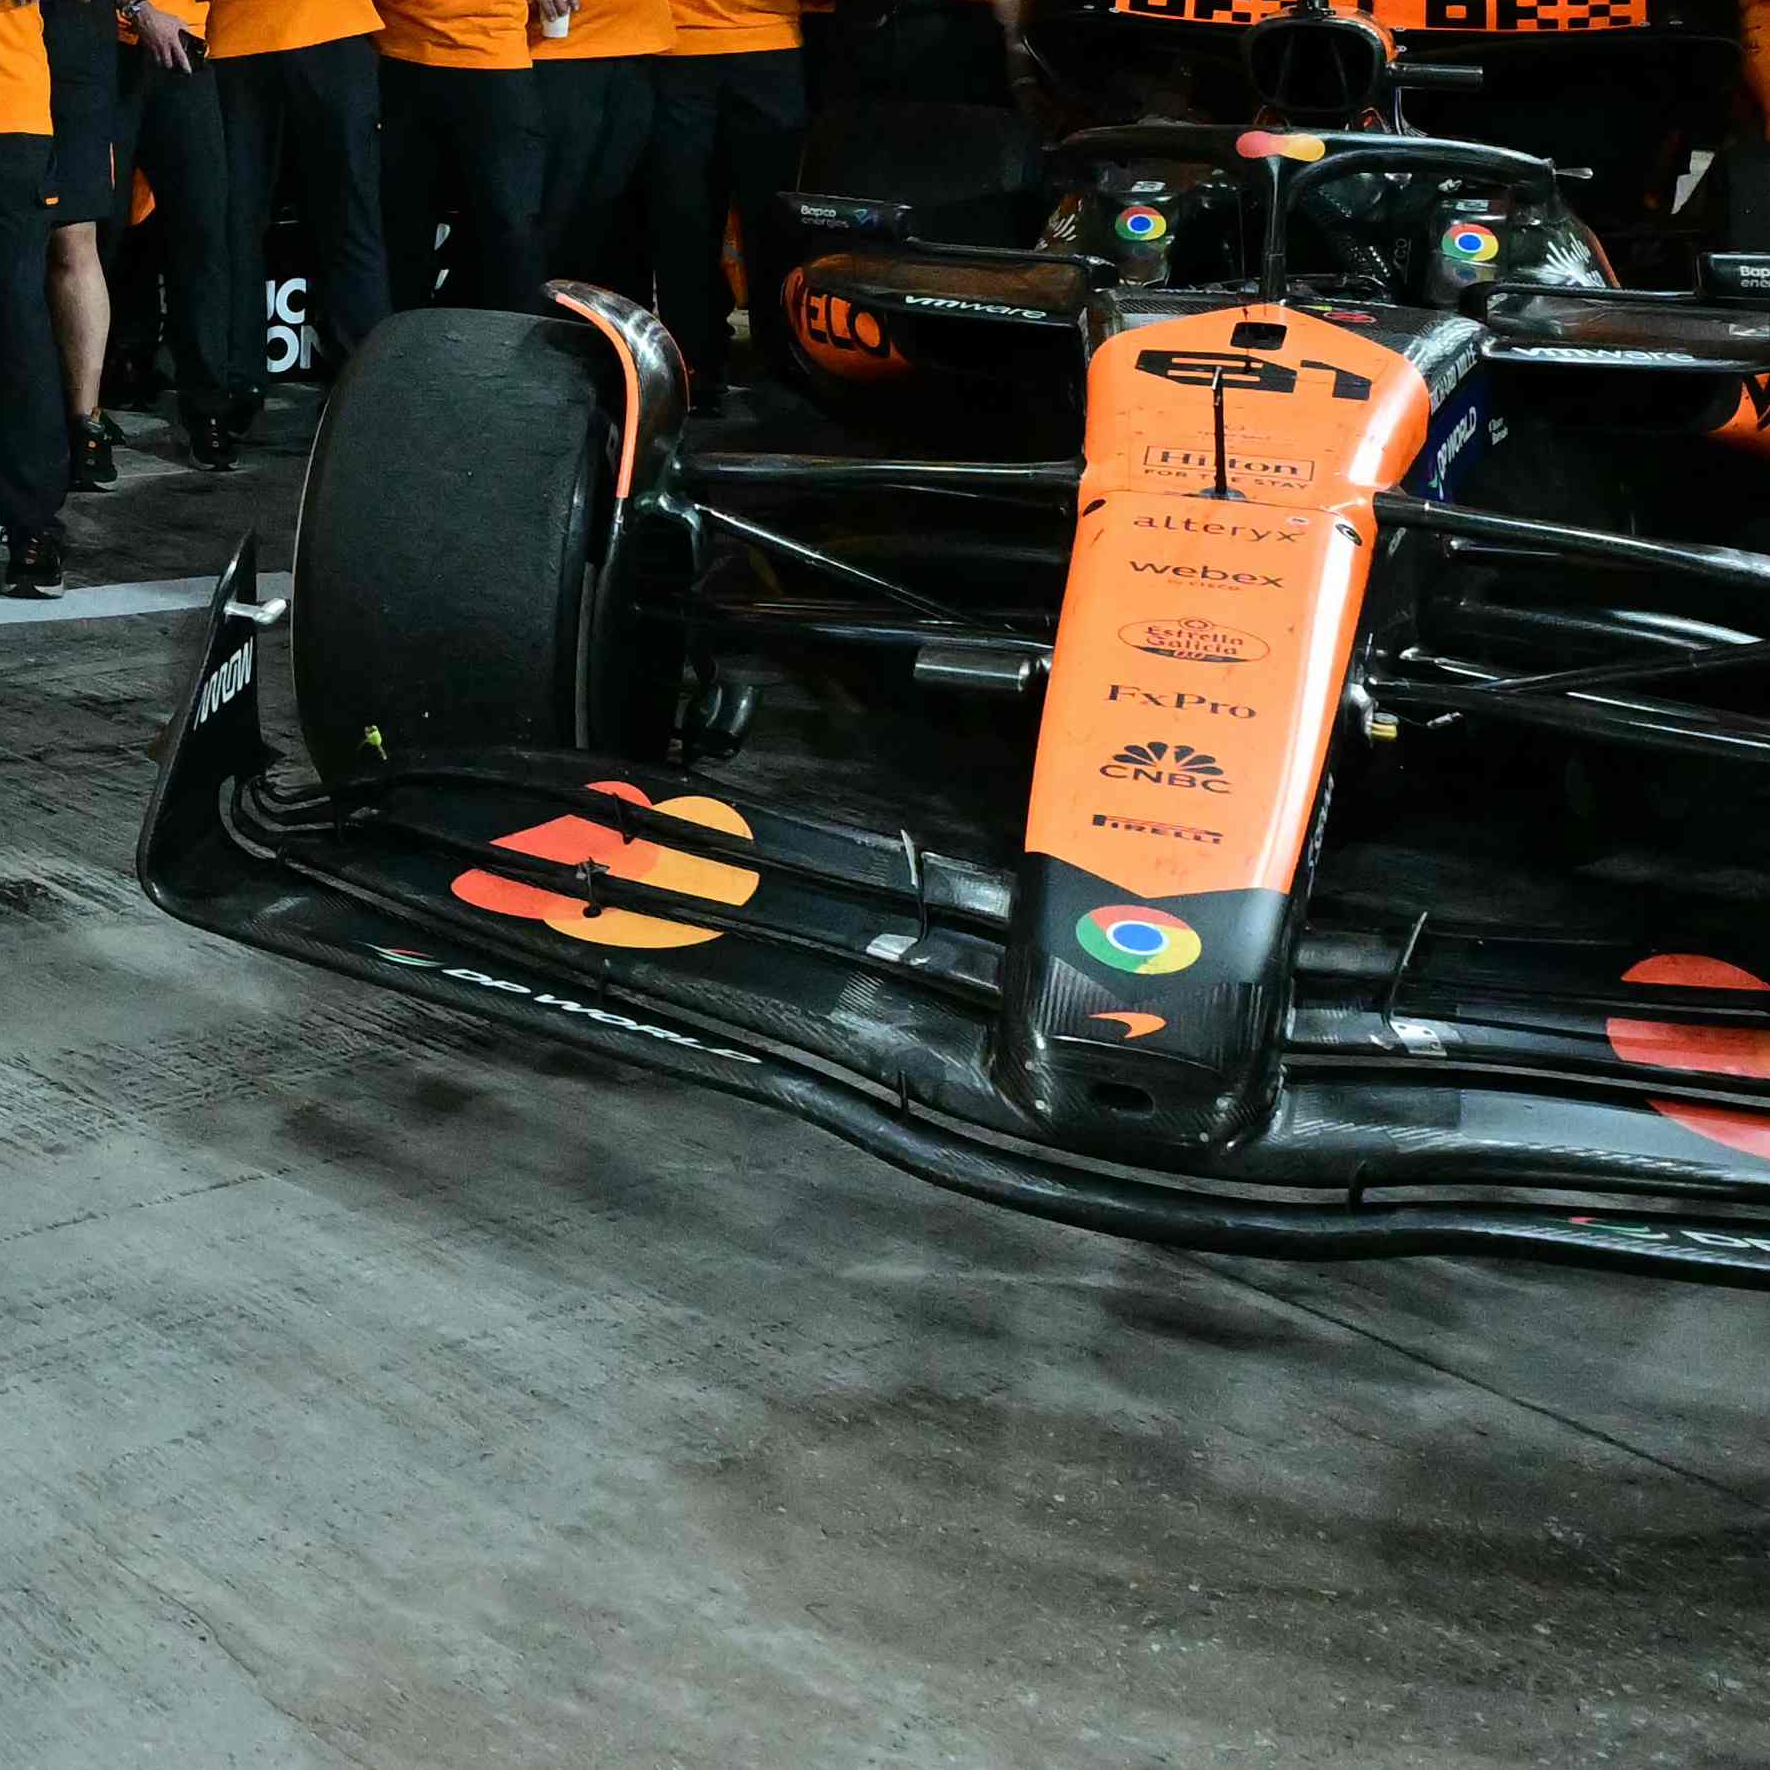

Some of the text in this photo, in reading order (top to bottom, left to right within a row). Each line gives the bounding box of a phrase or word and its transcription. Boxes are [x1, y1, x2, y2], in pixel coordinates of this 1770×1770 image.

[904, 294, 1048, 319] vmware
[1135, 349, 1373, 403] 81
[1143, 468, 1188, 479] FOR
[1199, 472, 1244, 483] TE
[1160, 450, 1299, 476] Hiton
[1132, 514, 1308, 543] alteryx
[1129, 560, 1286, 589] webex
[1146, 625, 1244, 646] Estrella
[1106, 683, 1258, 720] FxPro
[1098, 763, 1233, 796] CNBC
[1091, 813, 1225, 845] PIRELLI
[440, 966, 762, 1066] DP WORLD
